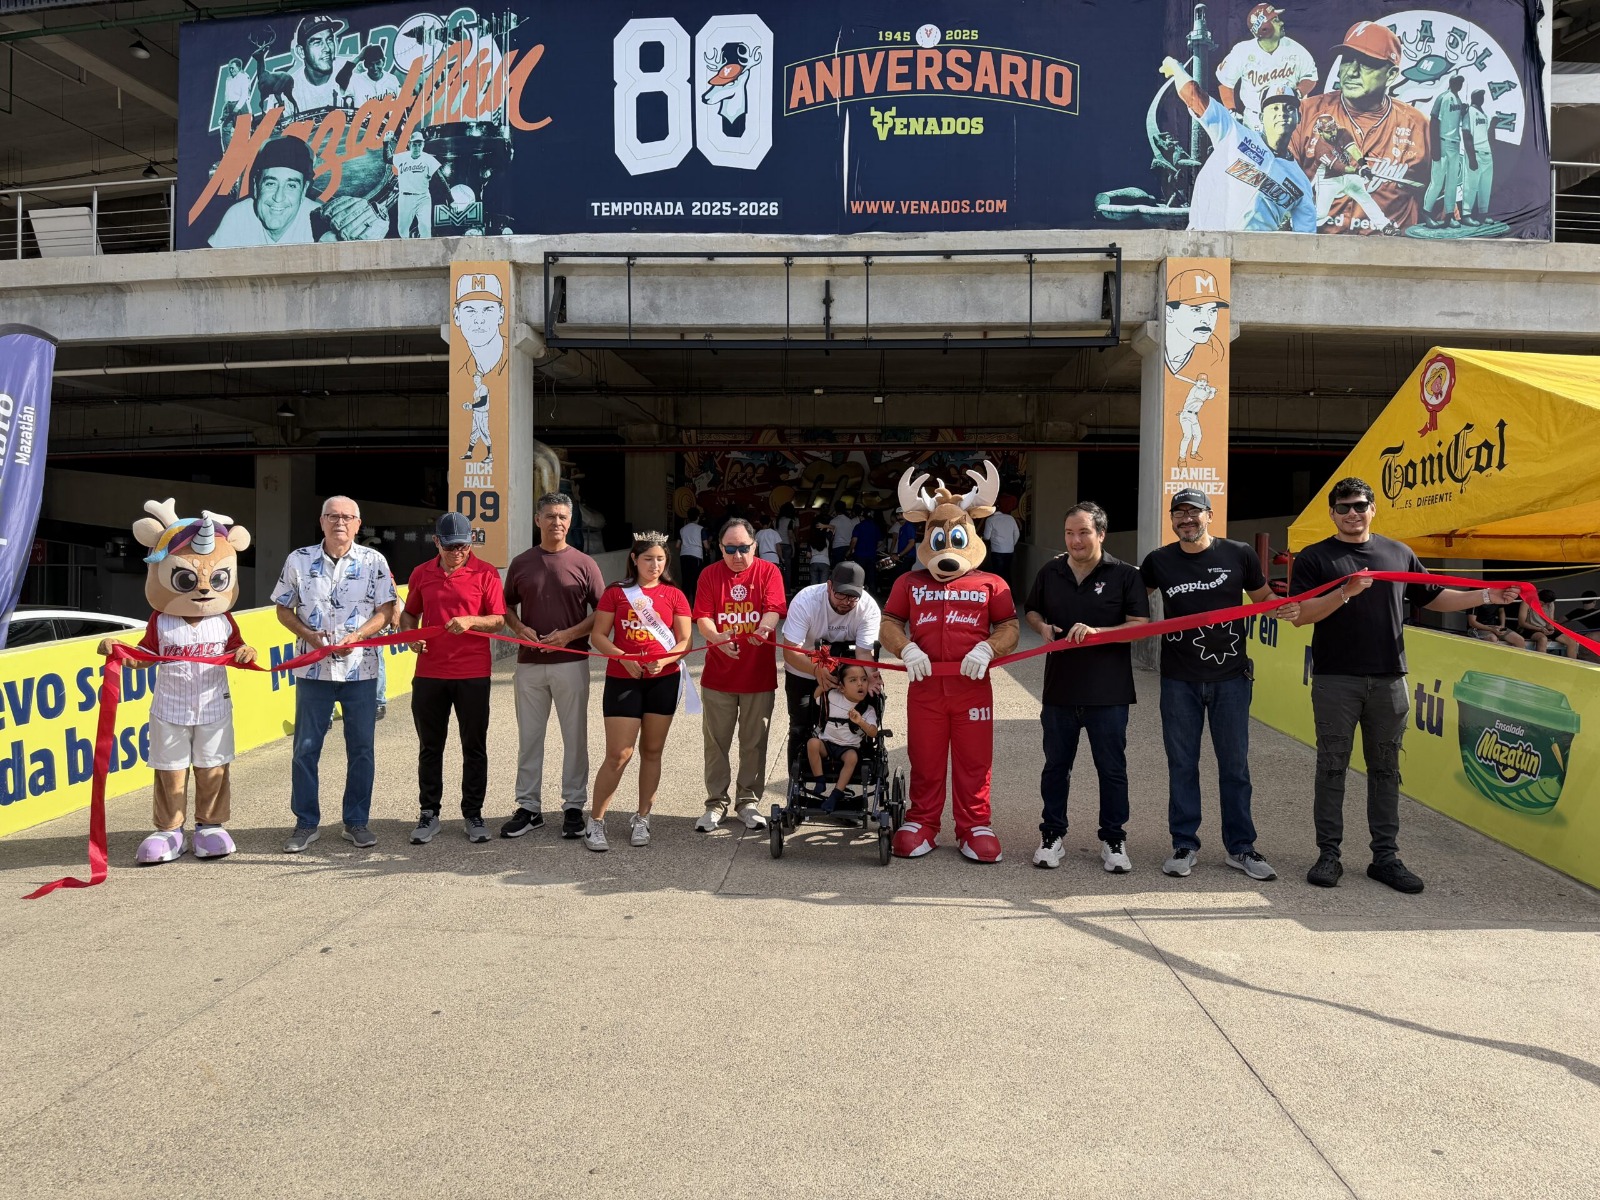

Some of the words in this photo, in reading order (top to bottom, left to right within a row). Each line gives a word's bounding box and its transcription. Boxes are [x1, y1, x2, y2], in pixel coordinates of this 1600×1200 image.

[878, 31, 911, 42] 1945
[945, 29, 979, 41] 2025
[1420, 59, 1435, 72] M
[789, 48, 1074, 109] ANIVERSARIO
[613, 14, 774, 176] 80
[870, 107, 984, 140] VENADOS
[591, 202, 684, 217] TEMPORADA
[691, 202, 779, 217] 2025-2026
[850, 199, 1008, 215] WWW.VENADOS.COM
[472, 276, 486, 290] M
[1195, 276, 1215, 293] M
[15, 405, 35, 466] Mazatlán
[465, 462, 493, 475] DICK
[1171, 467, 1220, 480] DANIEL
[463, 476, 494, 488] HALL
[456, 490, 500, 522] 09
[1416, 491, 1452, 508] DIFERENTE
[1166, 573, 1228, 598] Happiness
[724, 602, 754, 614] END
[717, 611, 760, 625] POLIO
[1259, 615, 1278, 648] en
[968, 706, 991, 720] 911
[1414, 679, 1445, 738] tú
[1495, 719, 1525, 737] Ensalada
[1477, 730, 1540, 775] Mazatún
